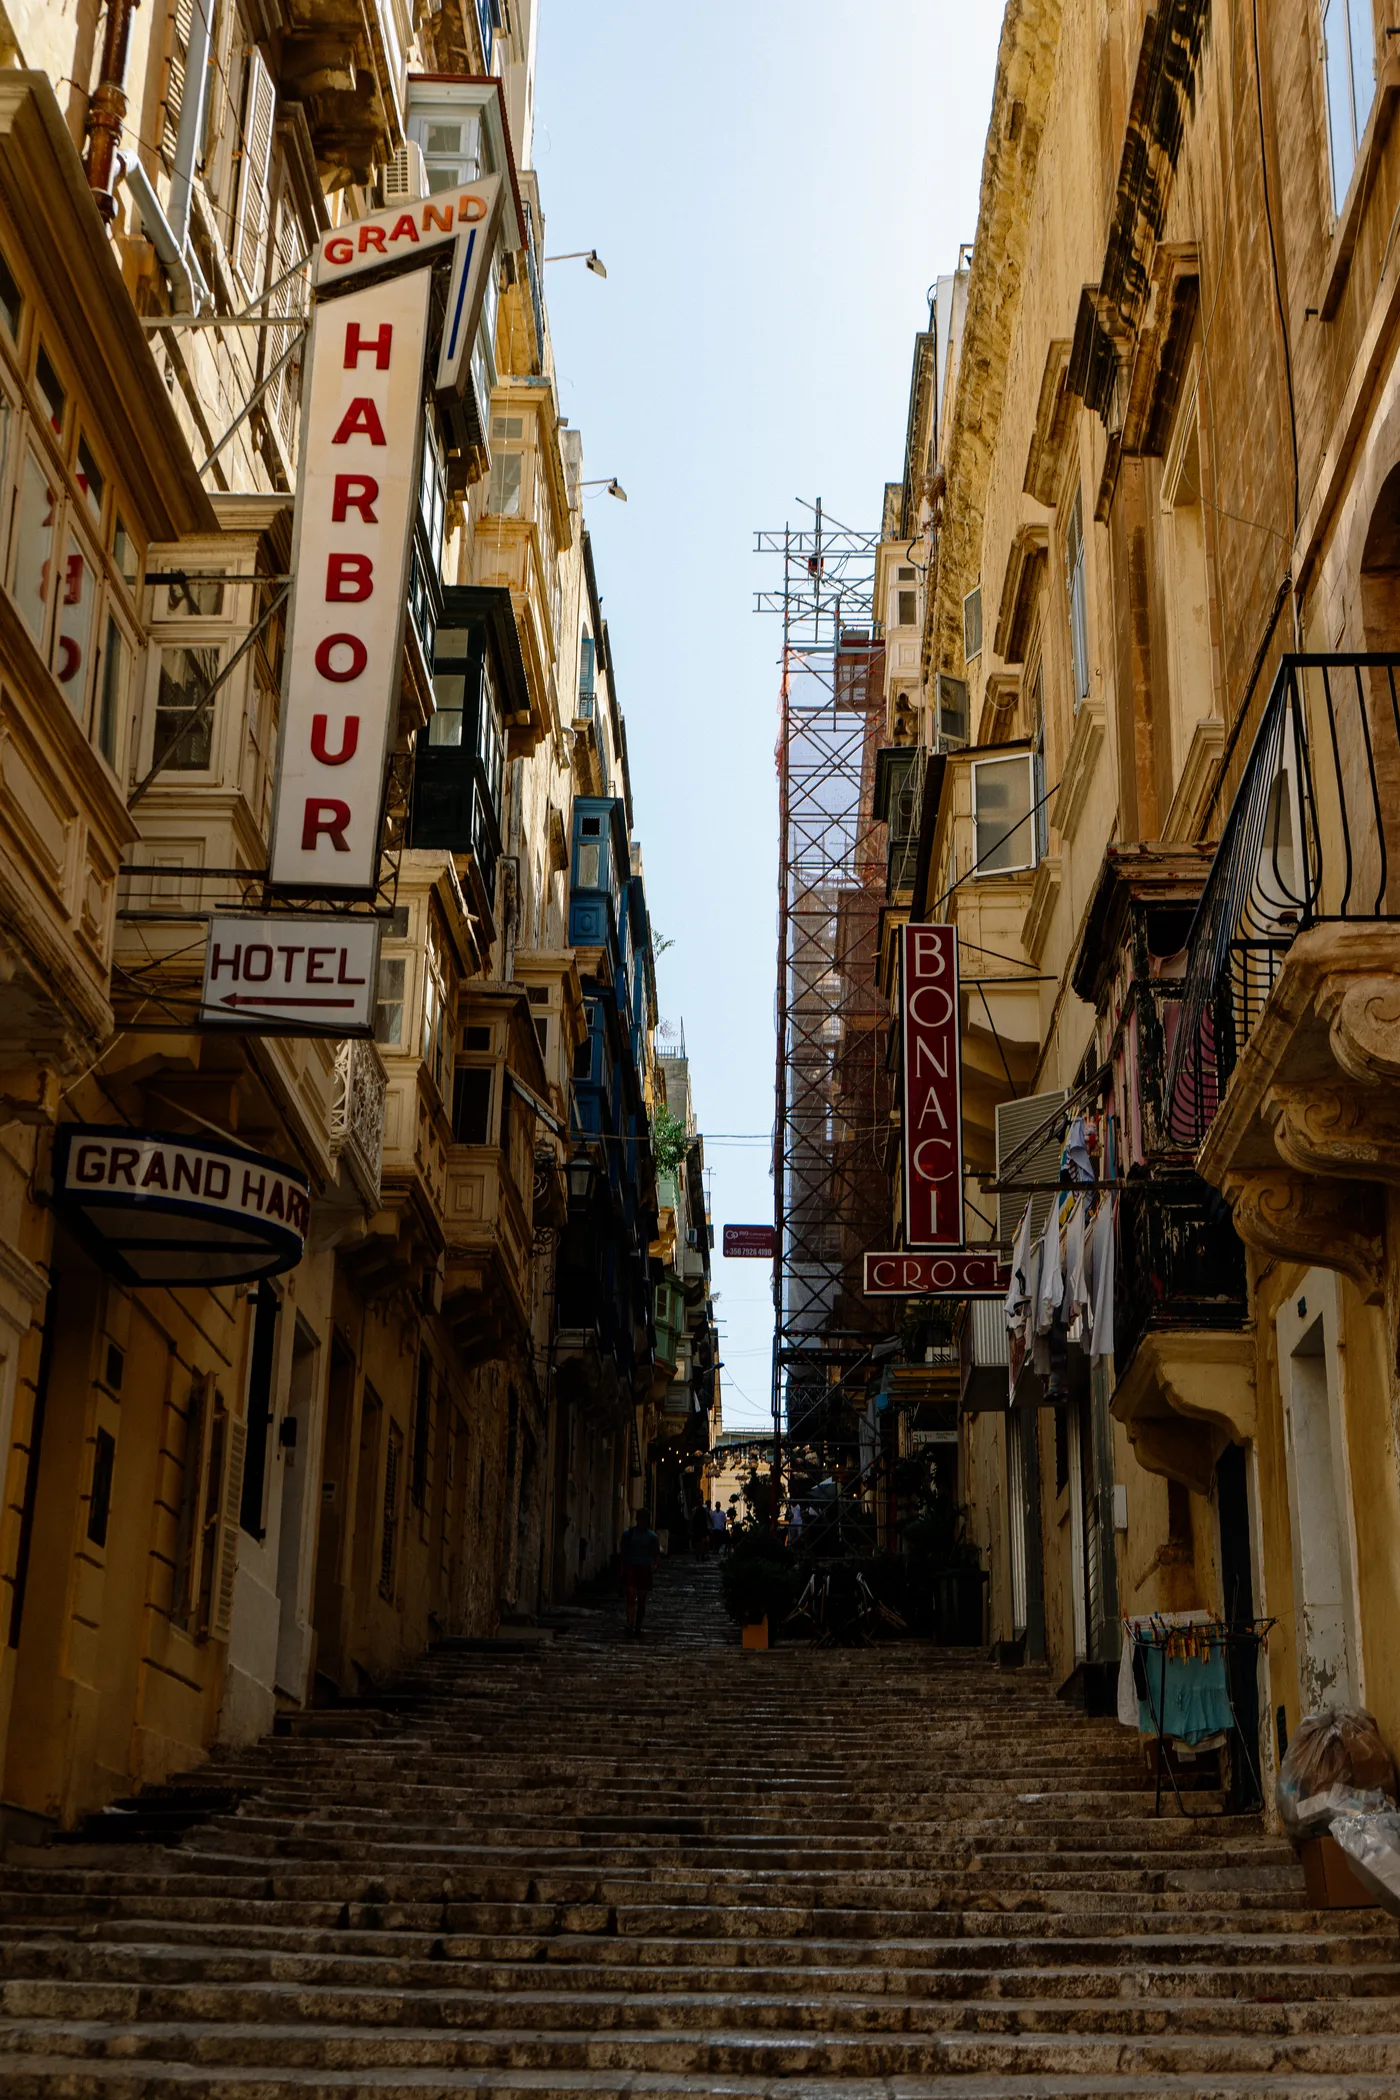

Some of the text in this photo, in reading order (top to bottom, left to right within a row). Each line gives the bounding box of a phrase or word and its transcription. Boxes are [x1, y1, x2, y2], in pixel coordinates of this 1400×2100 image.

[324, 195, 488, 266] GRAND
[301, 322, 393, 853] HARBOUR
[210, 943, 366, 986] HOTEL
[909, 932, 953, 1234] BONACI
[76, 1144, 231, 1200] GRAND
